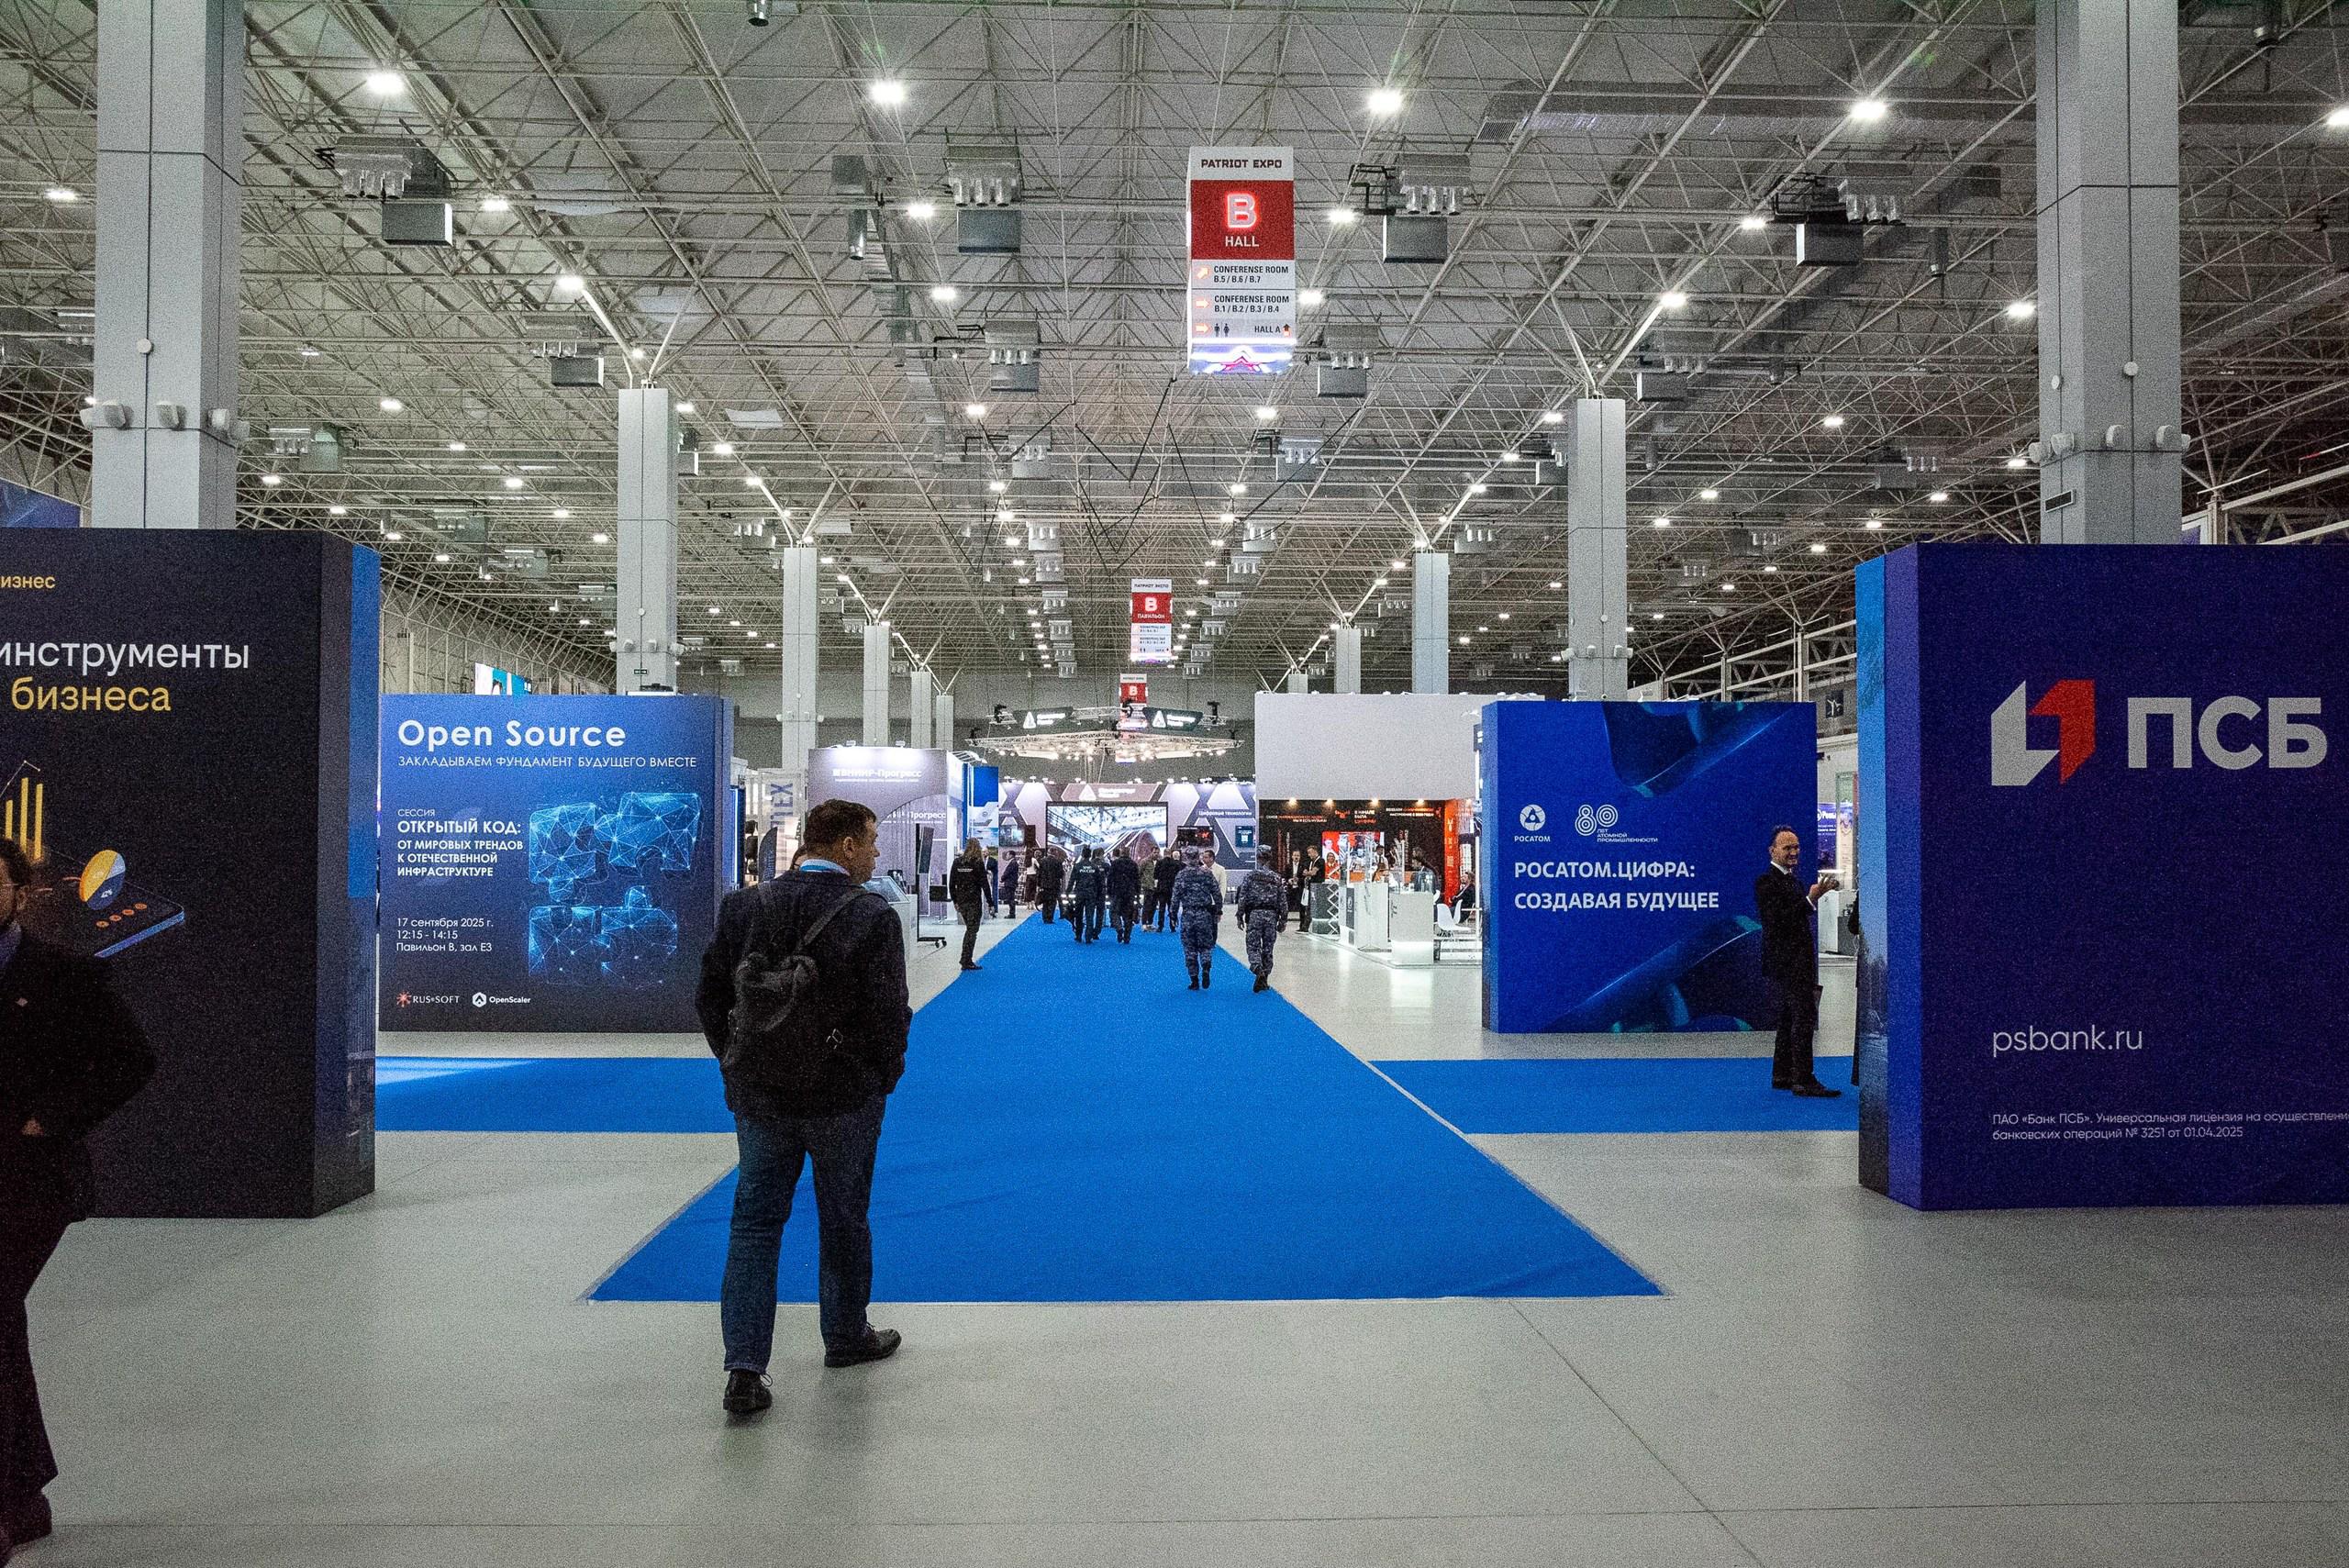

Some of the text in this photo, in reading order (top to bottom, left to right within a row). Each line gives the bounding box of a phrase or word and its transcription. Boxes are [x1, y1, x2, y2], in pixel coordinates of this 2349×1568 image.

[1201, 159, 1282, 169] PATRIOT EXPO
[1227, 193, 1257, 228] B
[1225, 235, 1260, 247] HALL
[1213, 265, 1288, 273] CONFERENSE ROOM
[11, 676, 172, 711] бизнеса
[398, 719, 626, 752] Open Source
[2127, 695, 2328, 770] ПСБ
[398, 756, 696, 768] ЗАКЛАДЫВАЕМ ФУНДАМЕНТ БУДУЩЕГО ВМЕСТЕ
[397, 808, 435, 817] СЕССИЯ
[397, 817, 521, 835] ОТКРЫТЫЙ КОД:
[397, 840, 523, 851] ОТ МИРОВЫХ ТРЕНДОВ
[397, 852, 497, 862] К ОТЕЧЕСТВЕННОЙ
[397, 867, 493, 876] ИНФРАСТРУКТУРЕ
[1514, 862, 1695, 881] РОСАТОМ.ЦИФРА:
[1514, 892, 1720, 912] СОЗДАВАЯ БУДУЩЕЕ
[397, 917, 407, 928] 17
[411, 917, 458, 929] сентября
[461, 917, 484, 927] 2025
[397, 930, 423, 940] 12:15
[433, 930, 458, 940] 14:15
[396, 942, 446, 951] Павильон
[489, 996, 531, 1005] OpenScaler
[1993, 1024, 2143, 1058] psbank.ru
[1993, 1114, 2018, 1125] ПАО
[2022, 1113, 2055, 1124] «Банк
[2096, 1112, 2187, 1125] Универсальная
[2188, 1113, 2243, 1123] лицензия
[2246, 1113, 2261, 1122] на
[2264, 1112, 2349, 1123] осуществлени
[1993, 1126, 2243, 1140] банковских операций № 3251 от 01.04.2025
